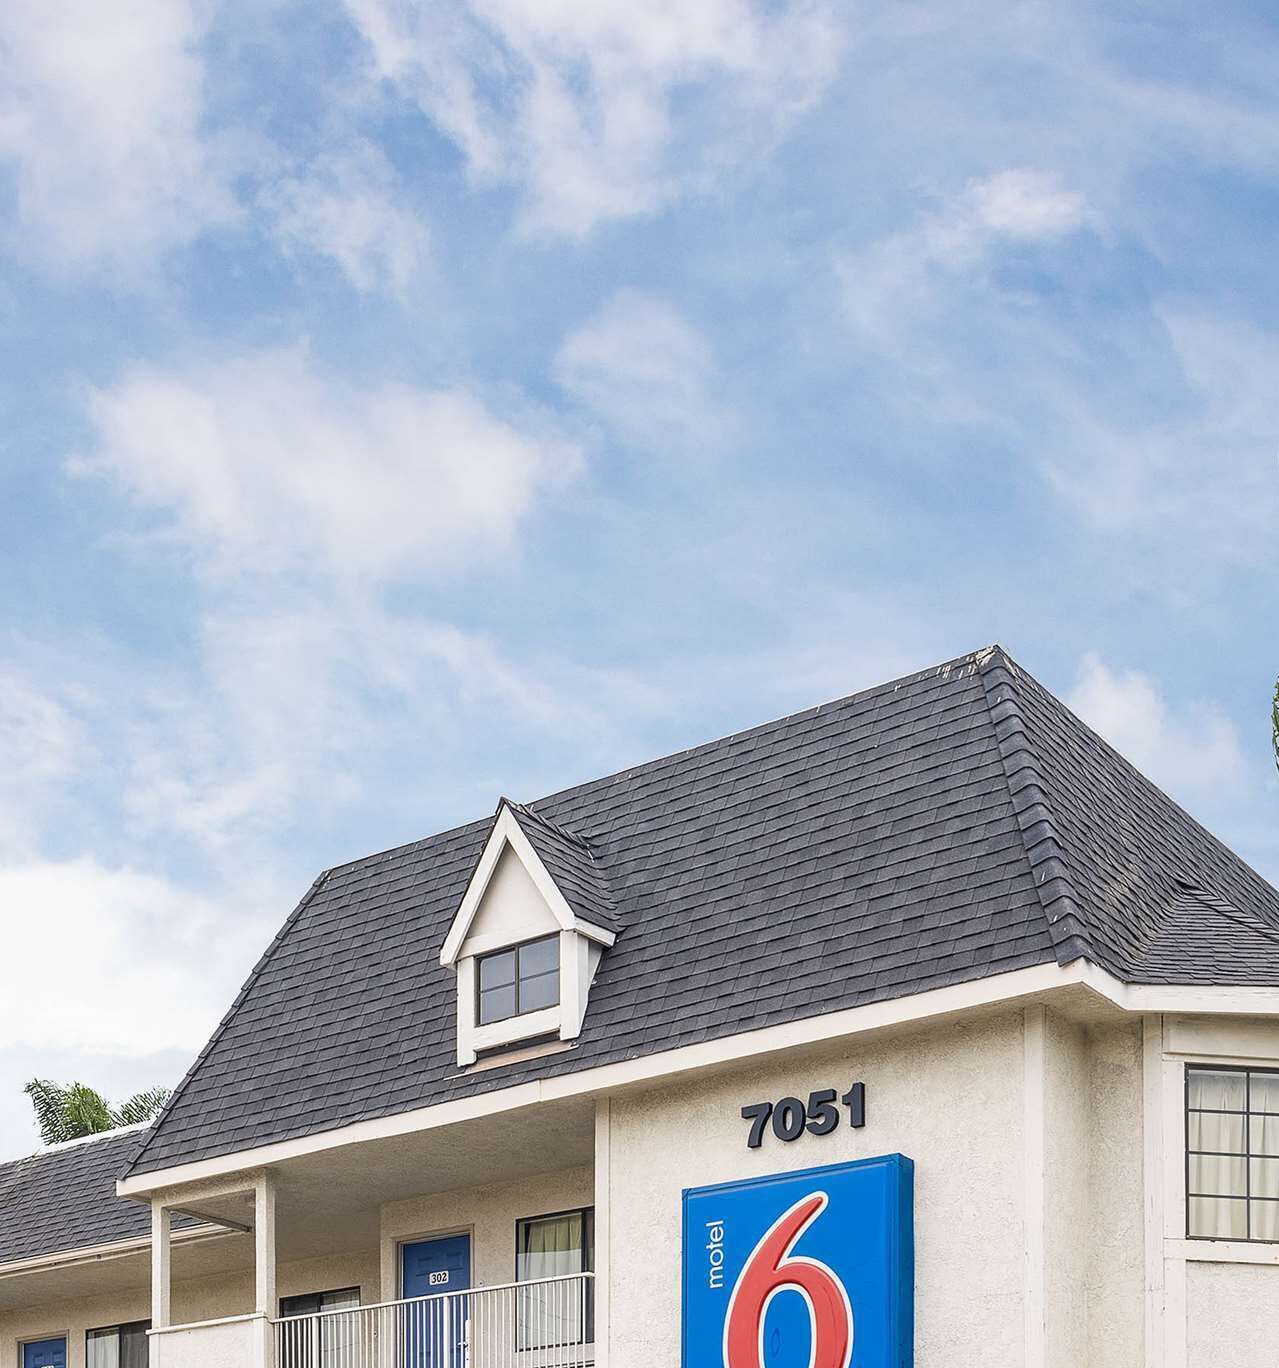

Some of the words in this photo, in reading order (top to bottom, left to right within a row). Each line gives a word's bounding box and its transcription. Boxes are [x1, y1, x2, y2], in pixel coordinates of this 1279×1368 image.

[741, 1081, 865, 1148] 7051
[431, 1272, 447, 1283] 302
[705, 1220, 724, 1288] motel
